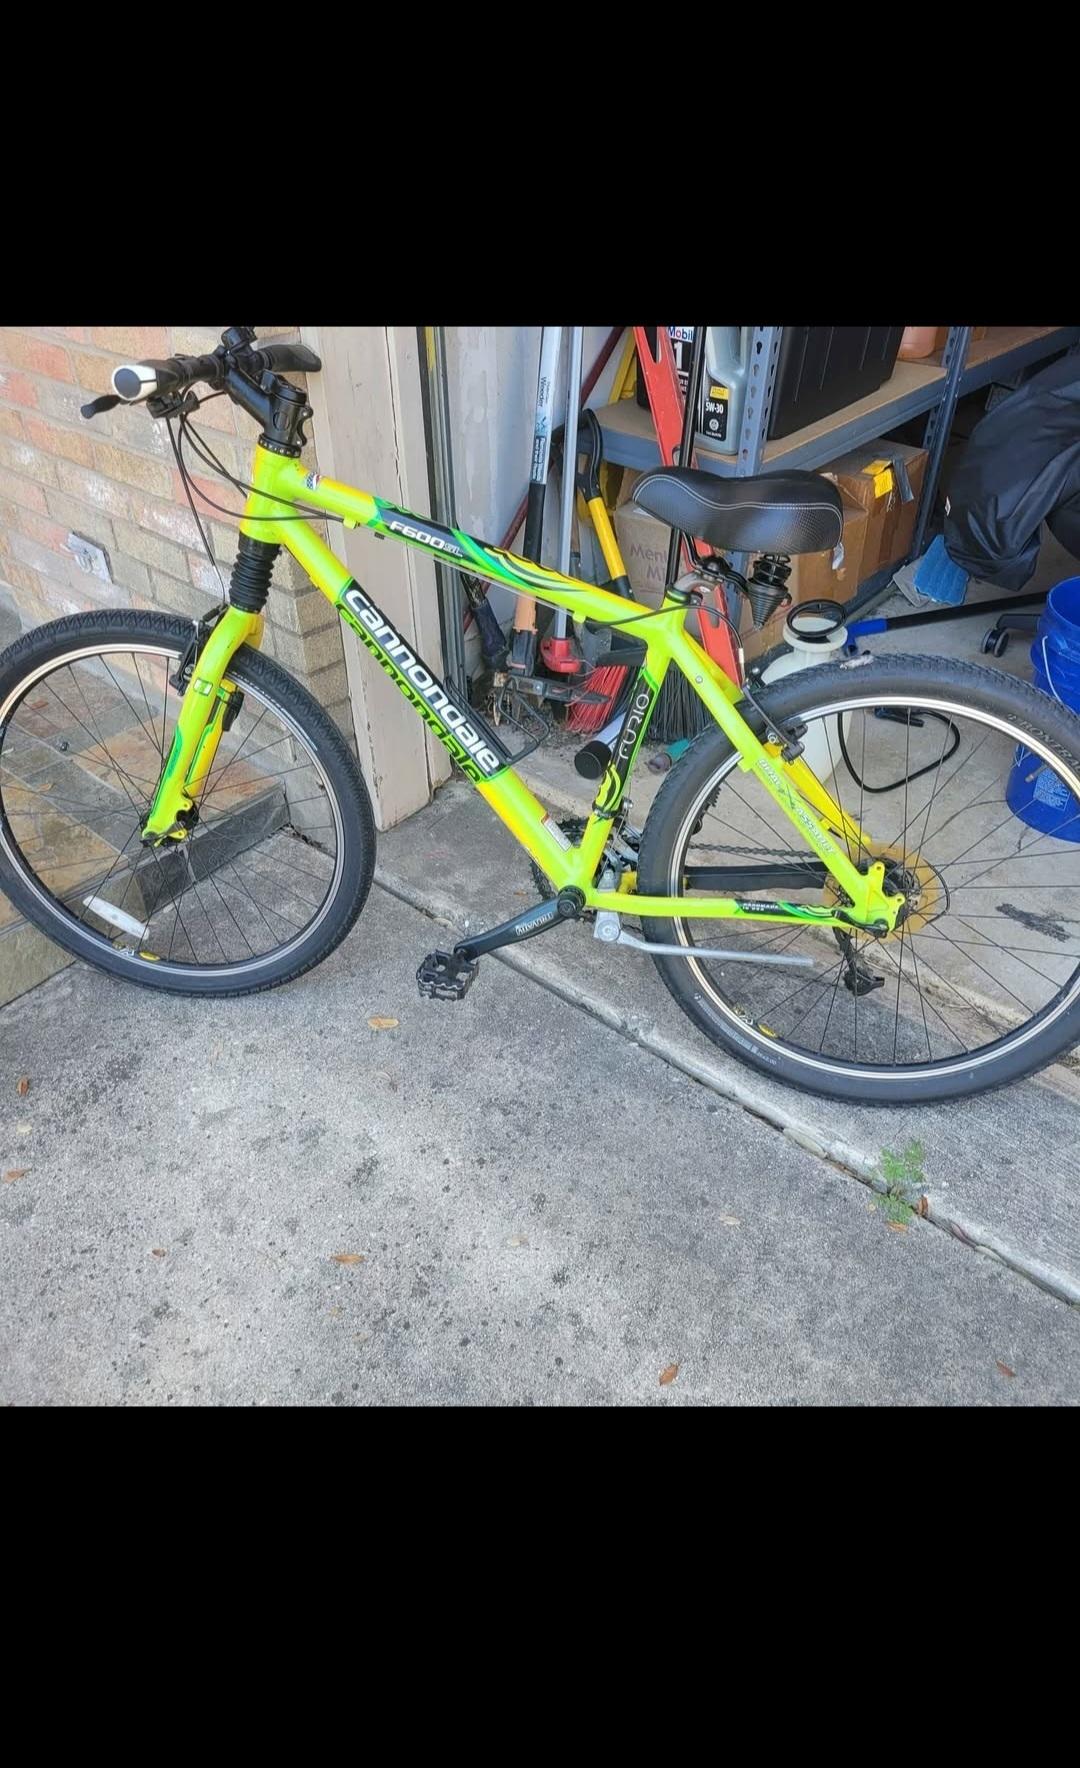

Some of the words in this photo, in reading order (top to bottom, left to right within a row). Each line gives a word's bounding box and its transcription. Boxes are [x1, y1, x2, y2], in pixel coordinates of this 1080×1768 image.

[668, 327, 694, 341] Mobil
[674, 341, 683, 370] 1
[705, 401, 724, 414] 5W-30
[389, 520, 446, 550] F600
[346, 589, 500, 773] cannondale
[619, 693, 650, 760] FURIO
